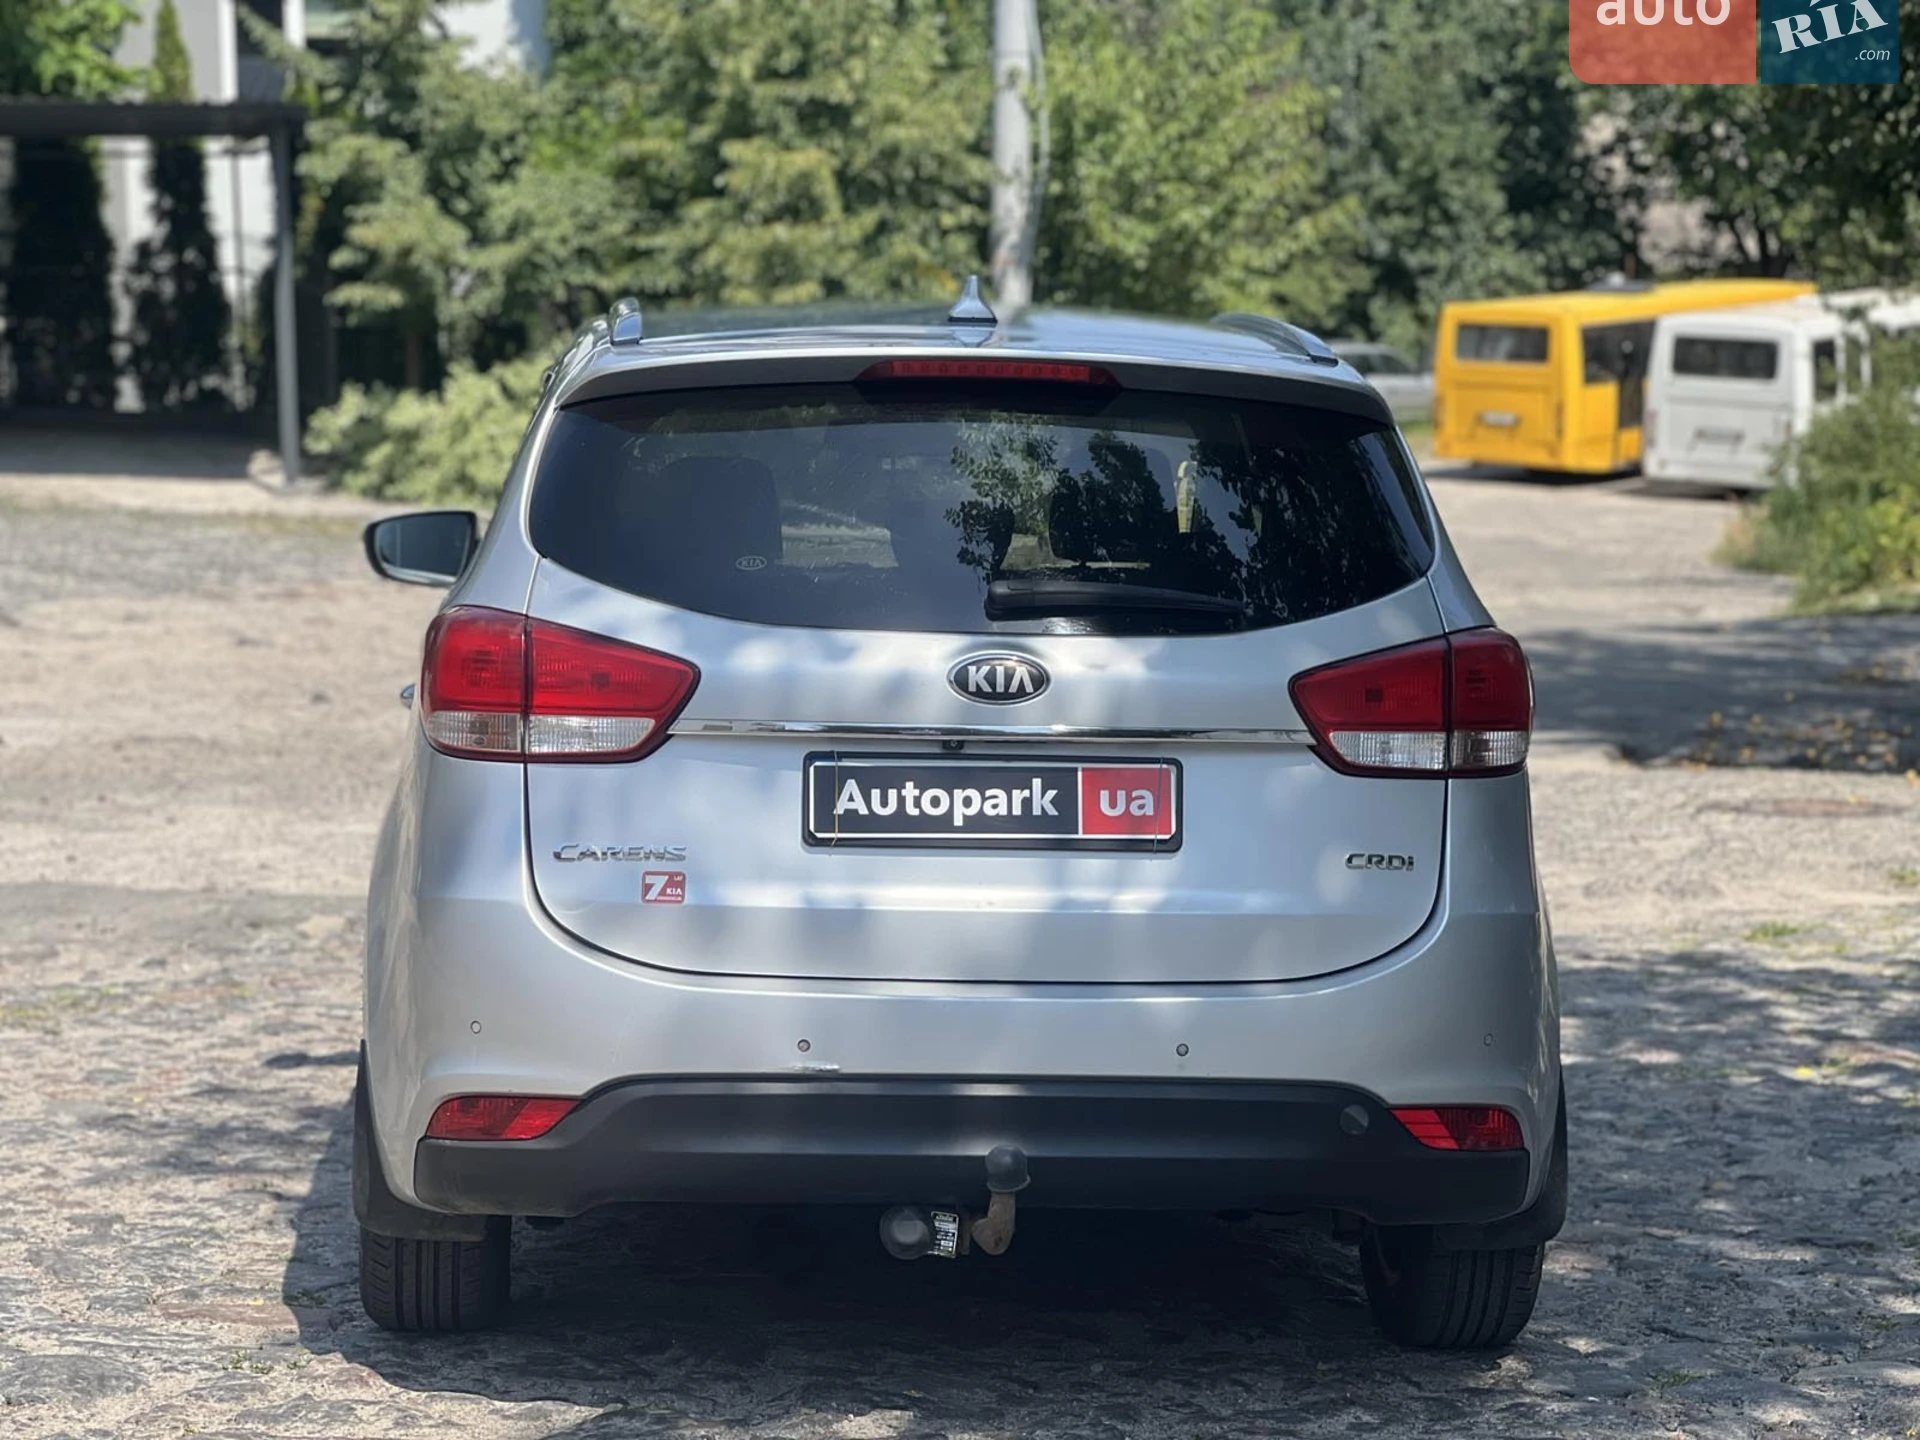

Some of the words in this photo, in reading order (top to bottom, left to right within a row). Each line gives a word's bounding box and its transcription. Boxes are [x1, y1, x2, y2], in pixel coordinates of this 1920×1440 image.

[967, 665, 1035, 693] KIA
[833, 777, 1059, 827] Autopark
[1100, 788, 1155, 817] ua
[553, 844, 688, 862] CARENS
[645, 875, 669, 900] 7
[666, 887, 682, 896] KIA
